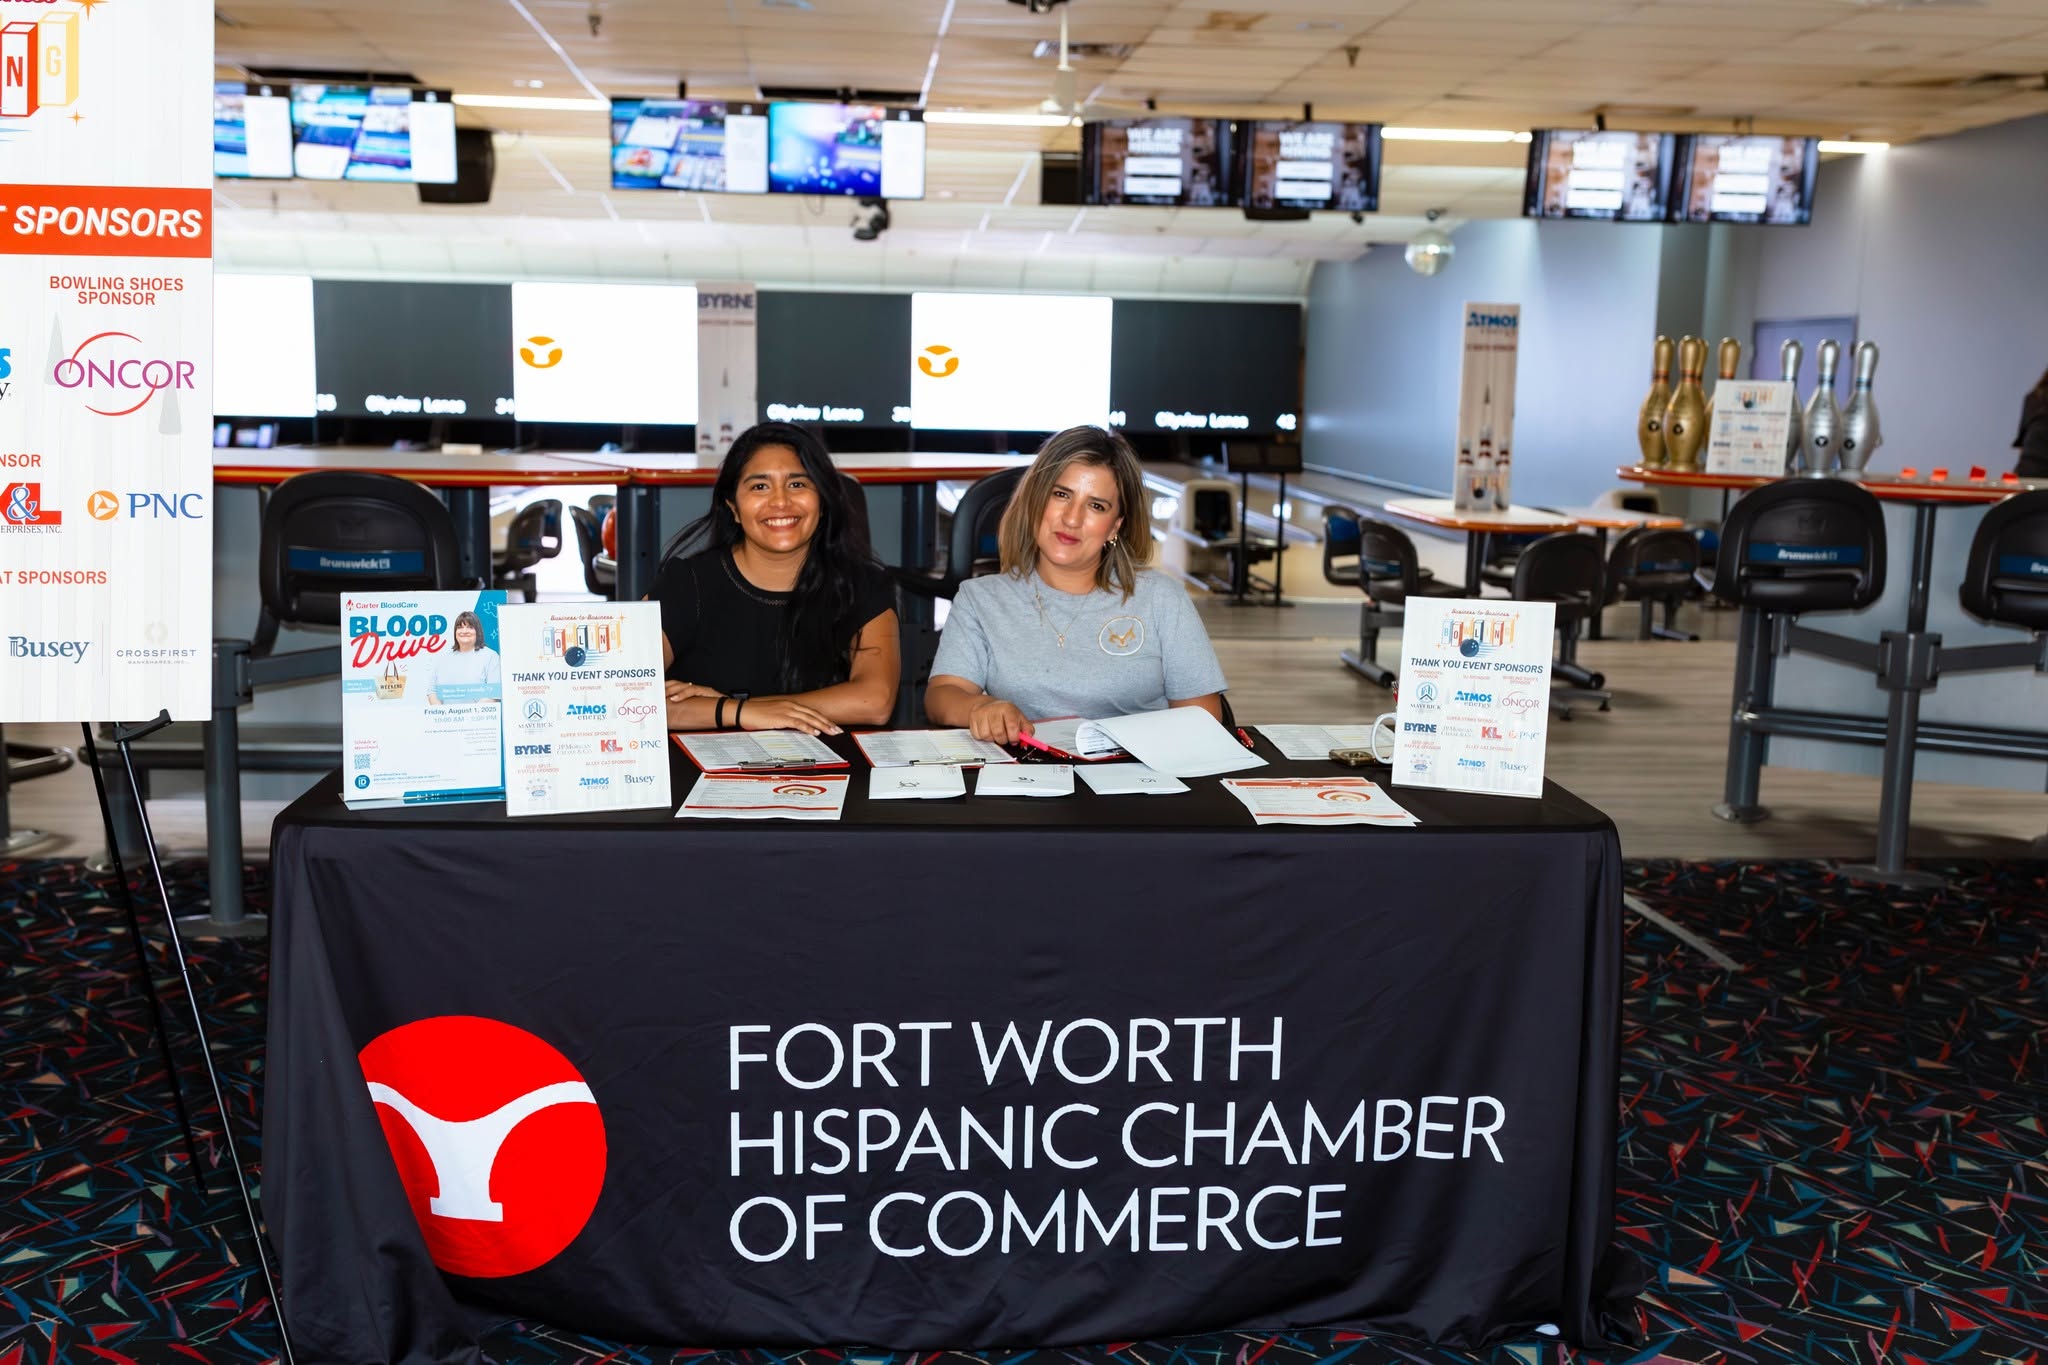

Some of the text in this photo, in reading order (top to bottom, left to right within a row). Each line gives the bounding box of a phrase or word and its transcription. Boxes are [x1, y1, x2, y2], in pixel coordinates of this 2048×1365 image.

[13, 205, 202, 238] SPONSORS
[50, 276, 184, 291] BOWLING SHOES
[78, 291, 155, 305] SPONSOR
[54, 359, 195, 389] ONCOR
[127, 493, 203, 518] PNC
[45, 525, 63, 534] INC.
[18, 570, 107, 584] SPONSORS
[349, 615, 447, 637] BLOOD
[8, 636, 89, 664] Busey
[116, 649, 197, 657] CROSSFIRST
[350, 630, 447, 668] Drive
[1411, 657, 1543, 674] THANK YOU EVENT SPONSORS
[512, 668, 656, 682] THANK YOU EVENT SPONSORS
[1455, 691, 1492, 703] ATMOS
[1502, 698, 1539, 708] ONCOR
[424, 708, 447, 716] Friday,
[448, 707, 472, 715] August
[567, 704, 606, 715] ATMOS
[618, 706, 657, 716] ONCOR
[1404, 722, 1437, 733] BYRNE
[515, 744, 551, 756] BYRNE
[640, 740, 661, 749] PNC
[1458, 758, 1486, 767] ATMOS
[579, 777, 609, 786] ATMOS
[625, 775, 655, 784] Busey
[730, 1017, 1282, 1090] FORT WORTH
[731, 1096, 1505, 1176] HISPANIC CHAMBER
[730, 1184, 1346, 1262] OF COMMERCE
